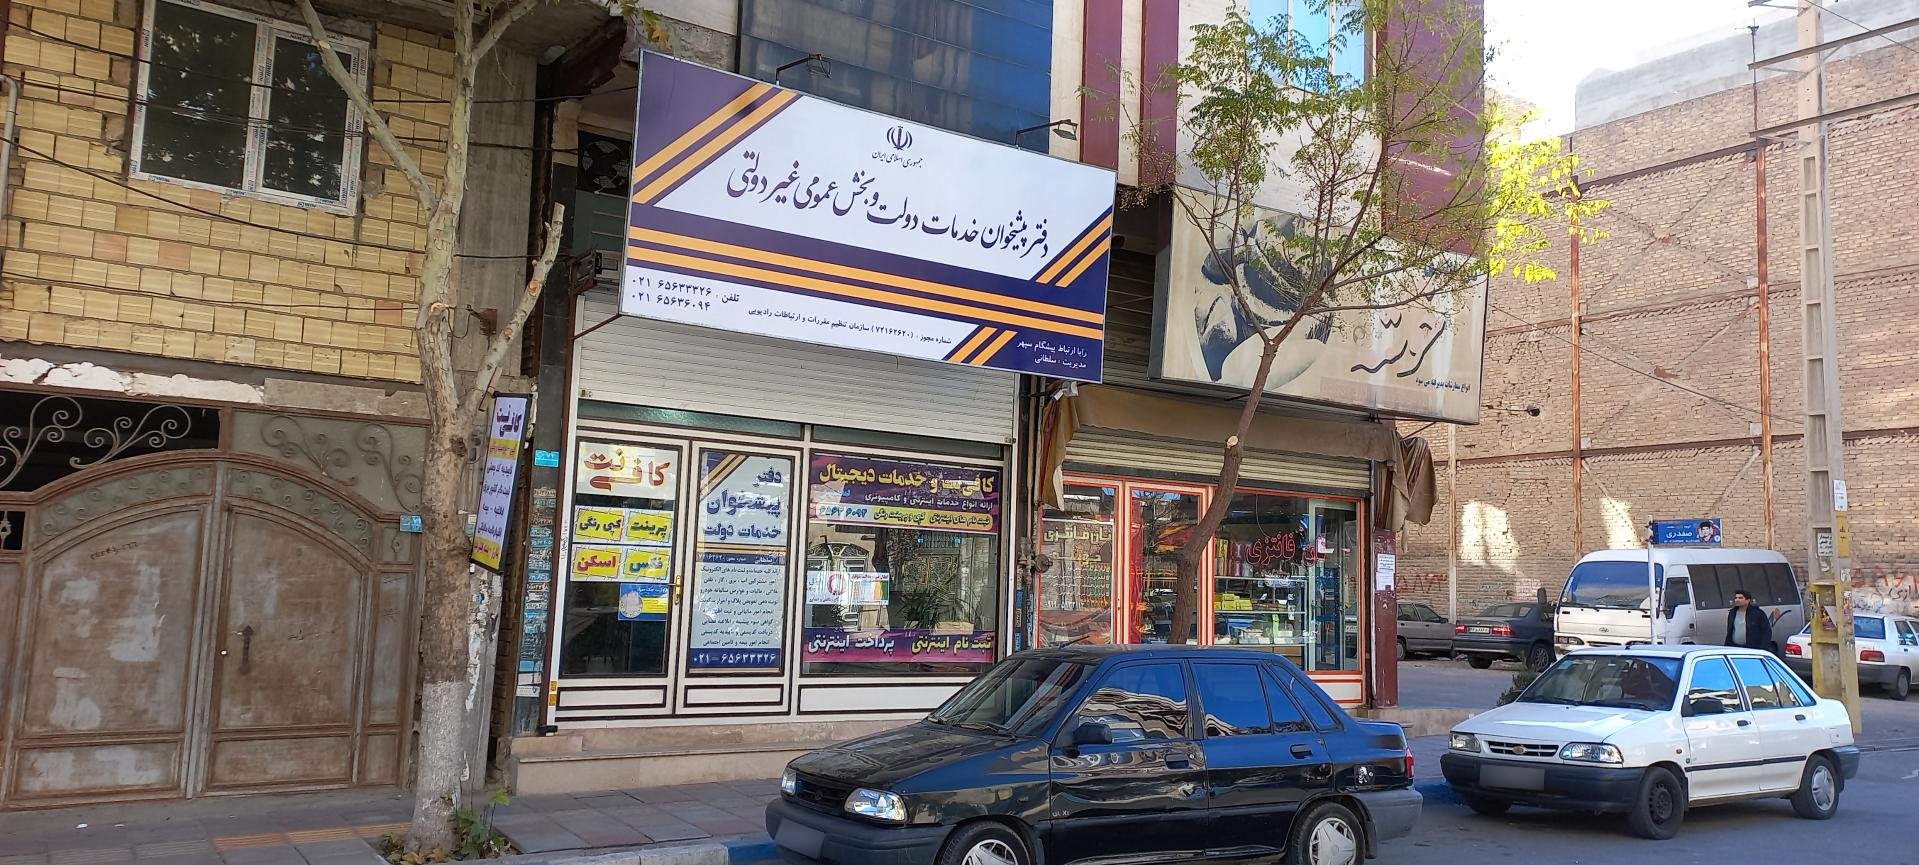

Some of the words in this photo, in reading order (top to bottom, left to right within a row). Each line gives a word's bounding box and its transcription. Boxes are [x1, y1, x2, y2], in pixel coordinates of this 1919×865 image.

[872, 151, 886, 162] ایران
[886, 153, 902, 163] اسلامی
[902, 157, 923, 168] جمهوری
[727, 150, 767, 198] دولتی
[759, 160, 800, 204] غیر
[793, 176, 838, 209] عمومی
[833, 170, 875, 216] بخش
[868, 191, 879, 207] و
[866, 196, 918, 230] دولت
[921, 213, 978, 242] خدمات
[981, 209, 1027, 250] پیشخوان
[1019, 218, 1048, 258] دفتر
[632, 276, 651, 288] ۰۲۱
[657, 279, 712, 296] ۶۵۶۳۳۳۲۶
[631, 291, 650, 302] ۰۲۱
[656, 293, 711, 311] ۶۵۶۳۶۰۹۴
[721, 293, 740, 304] تلفن
[748, 308, 773, 317] رادیویی
[774, 310, 801, 321] ارتباطات
[807, 316, 830, 325] مقررات
[831, 320, 847, 329] تنظیم
[848, 322, 869, 332] سازمان
[920, 335, 934, 343] مجوز
[935, 336, 952, 344] شماره
[1017, 340, 1033, 350] سپهر
[1034, 340, 1056, 354] پیشگام
[1058, 344, 1076, 356] ارتباط
[1034, 353, 1057, 364] سلطانی
[1062, 359, 1087, 369] مدیریت
[500, 412, 522, 437] کافی
[819, 463, 876, 484] دیجیتال
[878, 469, 927, 488] خدمات
[930, 477, 938, 493] و
[962, 475, 994, 496] کافی
[864, 493, 901, 504] کامپیوتری
[910, 496, 934, 505] اینترنتی
[937, 498, 959, 506] خدمات
[962, 501, 977, 510] انواع
[579, 517, 600, 531] رنگی
[930, 512, 953, 524] اینترنتی
[953, 515, 966, 525] های
[603, 518, 622, 535] کپی
[630, 519, 668, 538] پرینت
[704, 522, 734, 541] دولت
[738, 524, 782, 539] خدمات
[1044, 525, 1090, 542] فانتزی
[1665, 530, 1693, 539] صفدری
[1090, 526, 1112, 545] نان
[1246, 531, 1296, 566] فانتزی
[577, 555, 617, 572] اسکن
[629, 556, 664, 572] فکس
[808, 634, 850, 655] اینترنتی
[855, 635, 895, 654] پرداخت
[911, 636, 950, 655] اینترنتی
[954, 638, 969, 656] نام
[971, 635, 992, 655] ثبت
